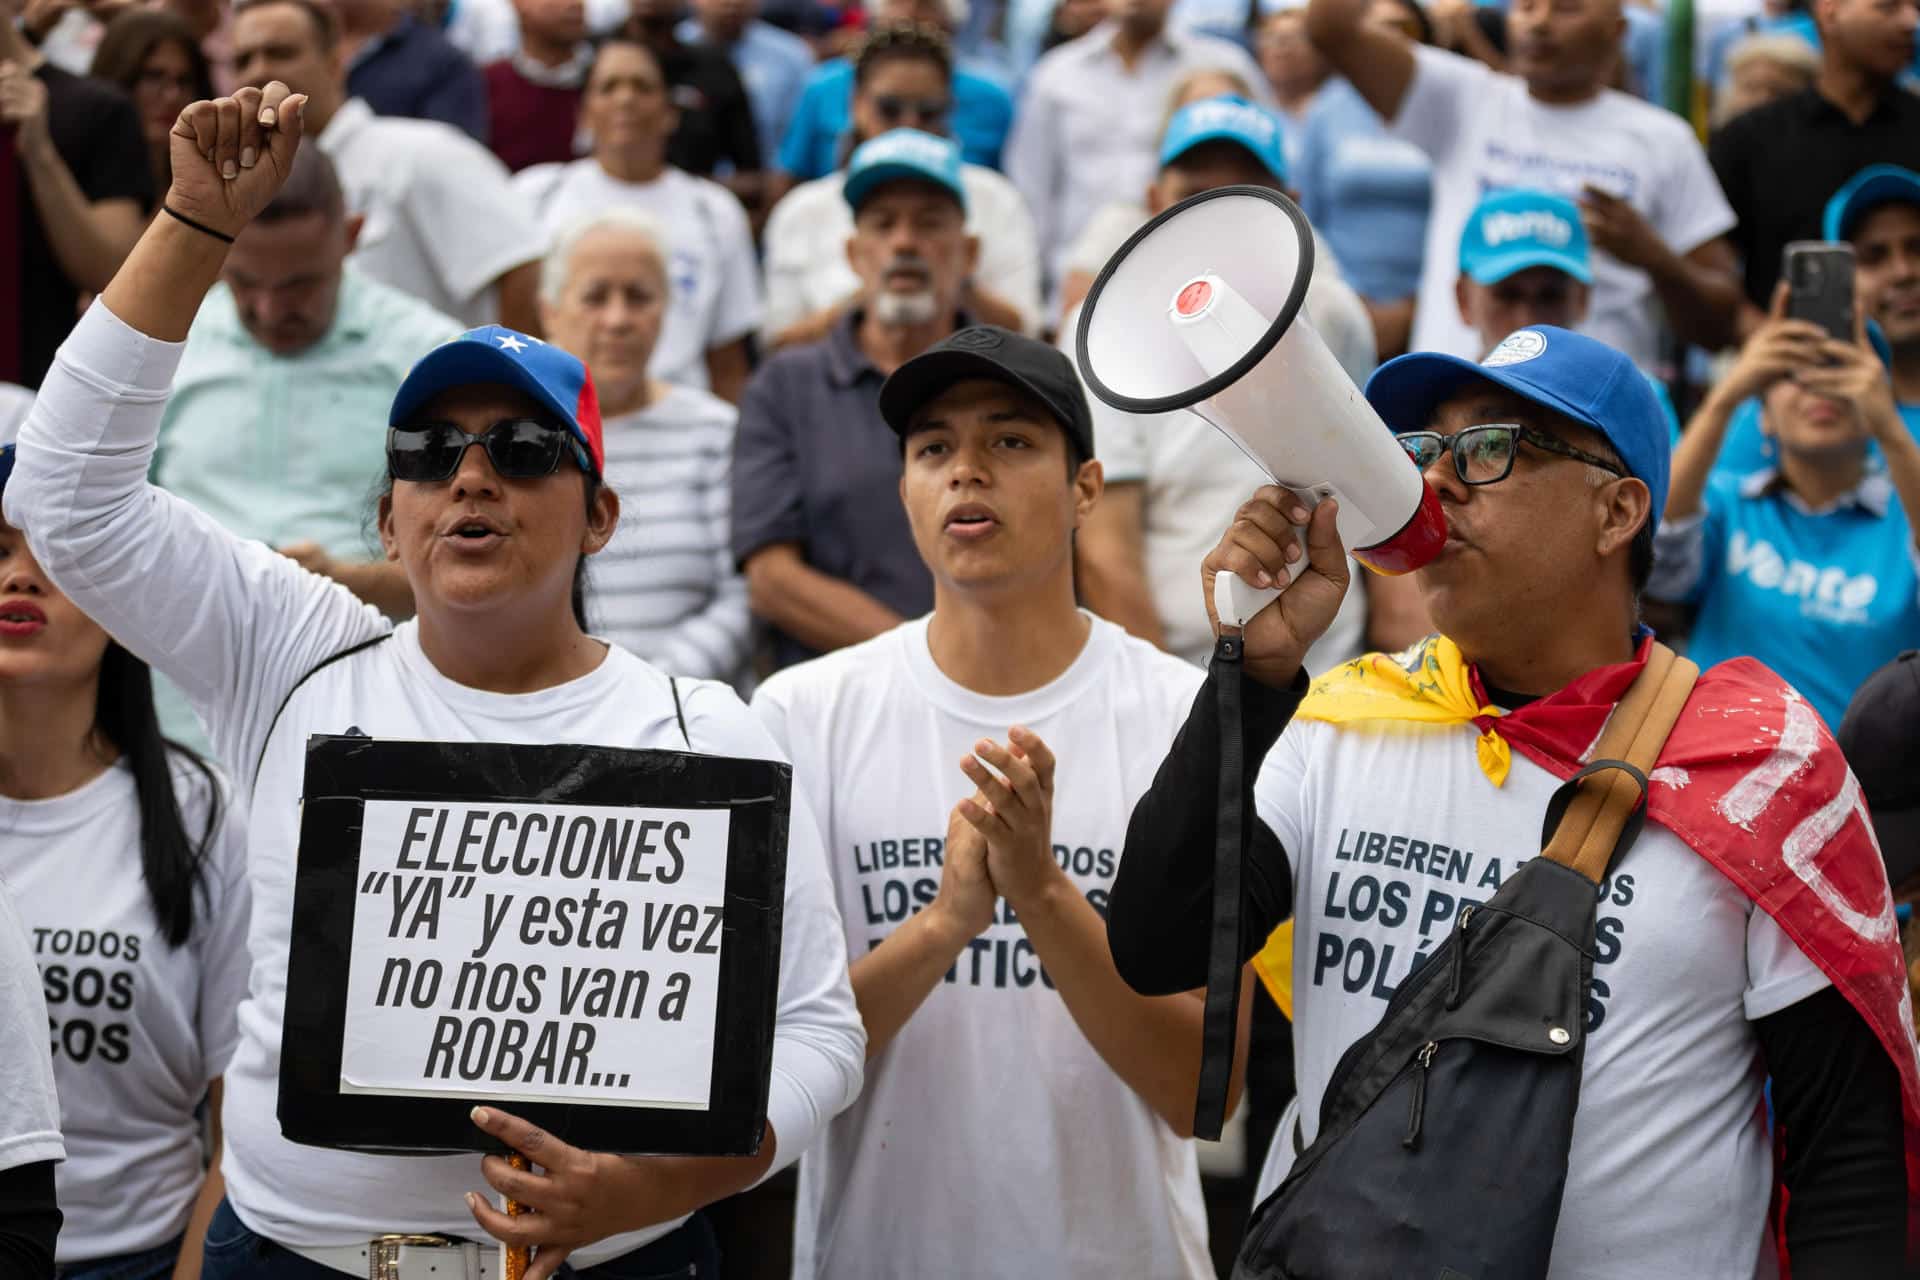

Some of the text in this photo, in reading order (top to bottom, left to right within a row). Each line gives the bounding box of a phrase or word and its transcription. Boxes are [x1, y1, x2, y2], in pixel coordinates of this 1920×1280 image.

[396, 807, 691, 885] ELECCIONES
[854, 837, 947, 875] LIBER
[1335, 828, 1474, 884] LIBEREN
[1478, 857, 1501, 890] A
[360, 871, 723, 959] “YA” y esta vez
[1323, 871, 1412, 929] LOS
[33, 927, 141, 964] TODOS
[375, 957, 691, 1022] no nos van a
[423, 1015, 631, 1088] ROBAR...
